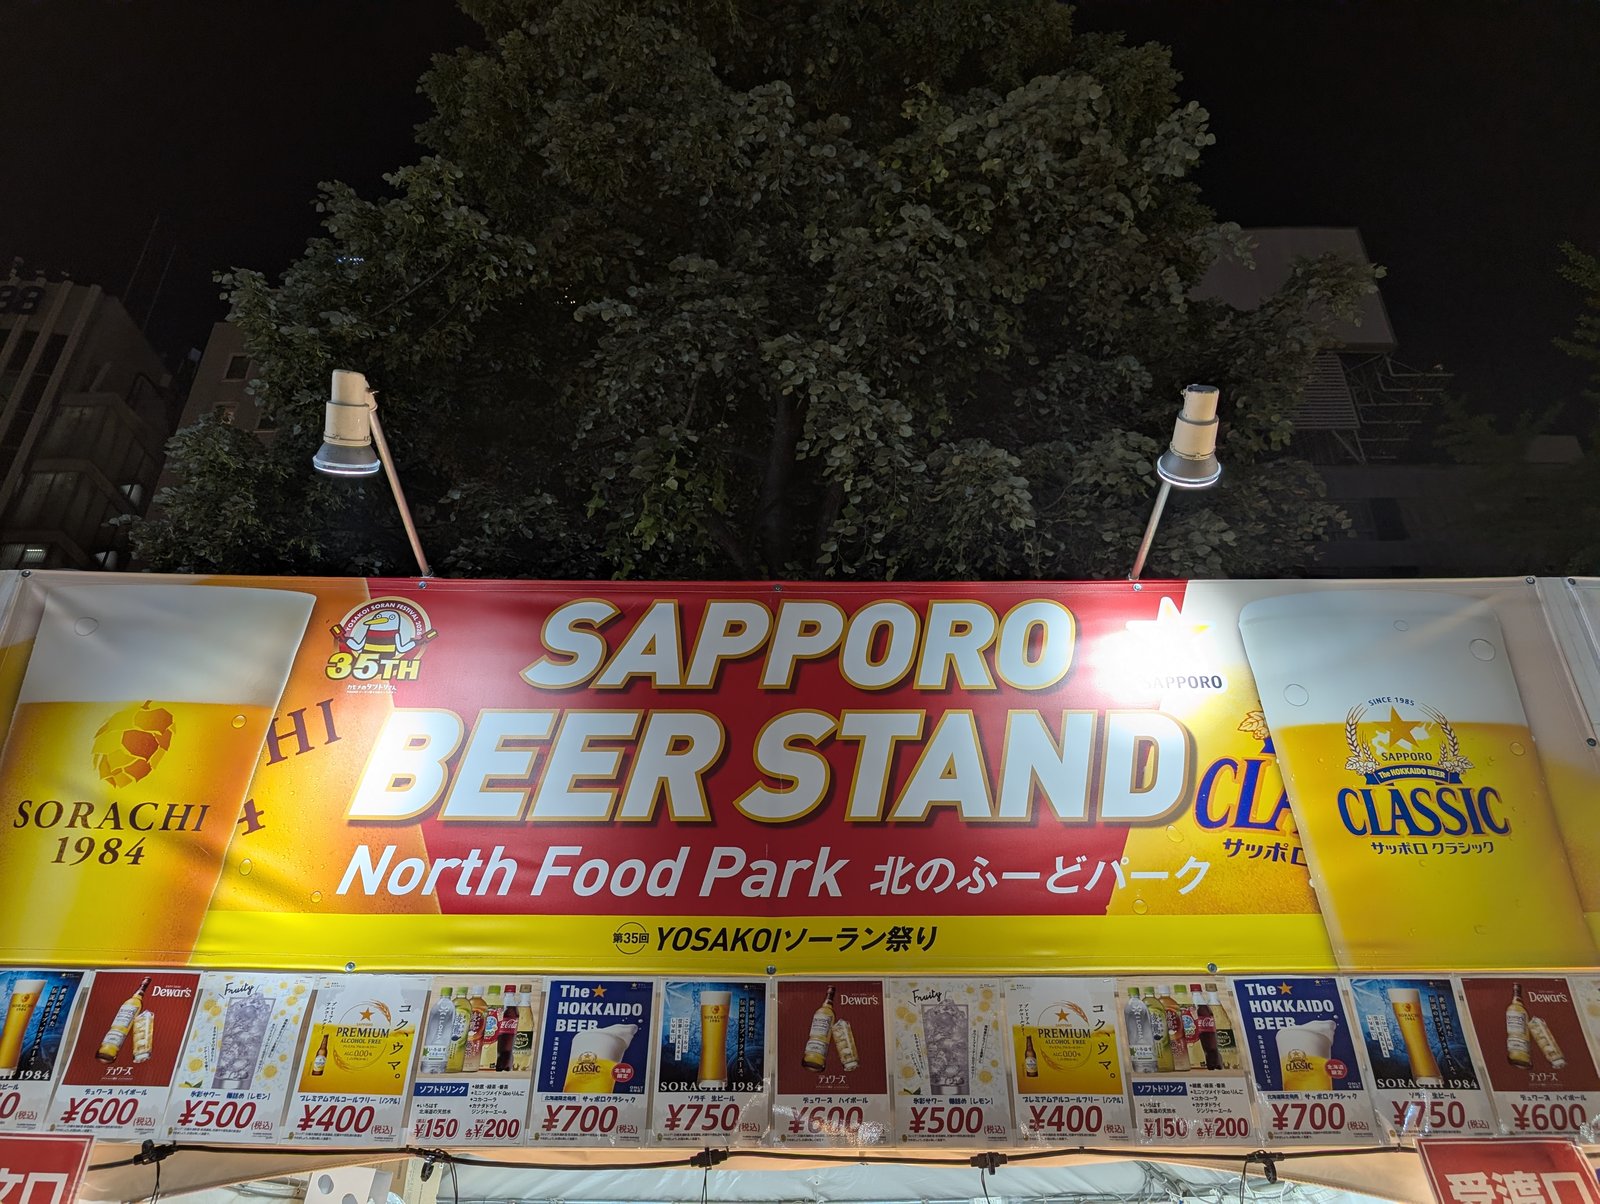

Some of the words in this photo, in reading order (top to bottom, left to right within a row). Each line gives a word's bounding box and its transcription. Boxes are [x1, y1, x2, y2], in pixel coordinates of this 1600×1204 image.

[345, 608, 370, 632] YOSAKOI
[371, 602, 396, 610] SORAN
[396, 603, 419, 622] FESTIVAL
[518, 598, 1077, 690] SAPPORO
[325, 651, 421, 680] 35TH
[1368, 696, 1392, 707] SINCE
[1394, 696, 1415, 707] 1985
[1381, 751, 1433, 762] SAPPORO
[349, 708, 726, 823] BEER
[732, 708, 1191, 823] STAND
[1377, 770, 1391, 780] The
[1390, 767, 1427, 778] HOKKAIDO
[1427, 768, 1446, 779] BEER
[13, 799, 210, 832] SORACHI
[1336, 786, 1512, 838] CLASSIC
[51, 835, 147, 867] 1984
[1370, 841, 1428, 855] サッポロ
[1432, 841, 1494, 854] クラシック
[336, 844, 518, 896] North
[530, 845, 690, 897] Food
[699, 846, 850, 898] Park
[869, 855, 1211, 897] 北のふーどパーク
[612, 931, 650, 946] 第35回
[656, 926, 938, 953] YOSAKOIソーラン祭り
[152, 985, 192, 997] Dewar's
[224, 982, 254, 996] Fruity
[560, 984, 590, 998] The
[912, 989, 942, 1003] Fruity
[1244, 983, 1277, 996] The
[840, 994, 879, 1005] Dewar's
[1528, 991, 1568, 1003] Dewar's
[557, 1001, 643, 1016] HOKKAIDO
[1249, 1000, 1335, 1013] HOKKAIDO
[555, 1018, 599, 1032] BEER
[1253, 1017, 1296, 1030] BEER
[336, 1027, 390, 1038] PREMIUM
[1038, 1028, 1091, 1038] PREMIUM
[572, 1062, 601, 1074] CLASSIC
[1286, 1059, 1314, 1072] CLASSIC
[19, 1070, 50, 1080] 1984
[419, 1085, 466, 1094] ソフトドリンク
[732, 1081, 763, 1092] 1984
[1138, 1085, 1184, 1093] ソフトドリンク
[1449, 1078, 1478, 1089] 1984
[0, 1092, 21, 1119] 0
[60, 1097, 139, 1125] ¥600
[15, 1110, 38, 1121] (税込)
[177, 1100, 257, 1129] ¥500
[297, 1104, 375, 1133] ¥400
[542, 1105, 618, 1133] ¥700
[664, 1104, 740, 1131] ¥750
[909, 1107, 984, 1134] ¥500
[1029, 1105, 1103, 1133] ¥400
[1271, 1103, 1346, 1130] ¥700
[133, 1118, 156, 1127] (税込)
[251, 1122, 273, 1131] (税込)
[414, 1118, 459, 1138] ¥150
[473, 1118, 520, 1138] ¥200
[616, 1124, 638, 1134] (税込)
[738, 1122, 761, 1132] (税込)
[1103, 1124, 1125, 1134] (税込)
[1144, 1117, 1188, 1137] ¥150
[1204, 1117, 1249, 1137] ¥200
[1347, 1121, 1369, 1131] (税込)
[1467, 1119, 1490, 1130] (税込)
[370, 1125, 393, 1135] (税込)
[984, 1125, 1006, 1135] (税込)
